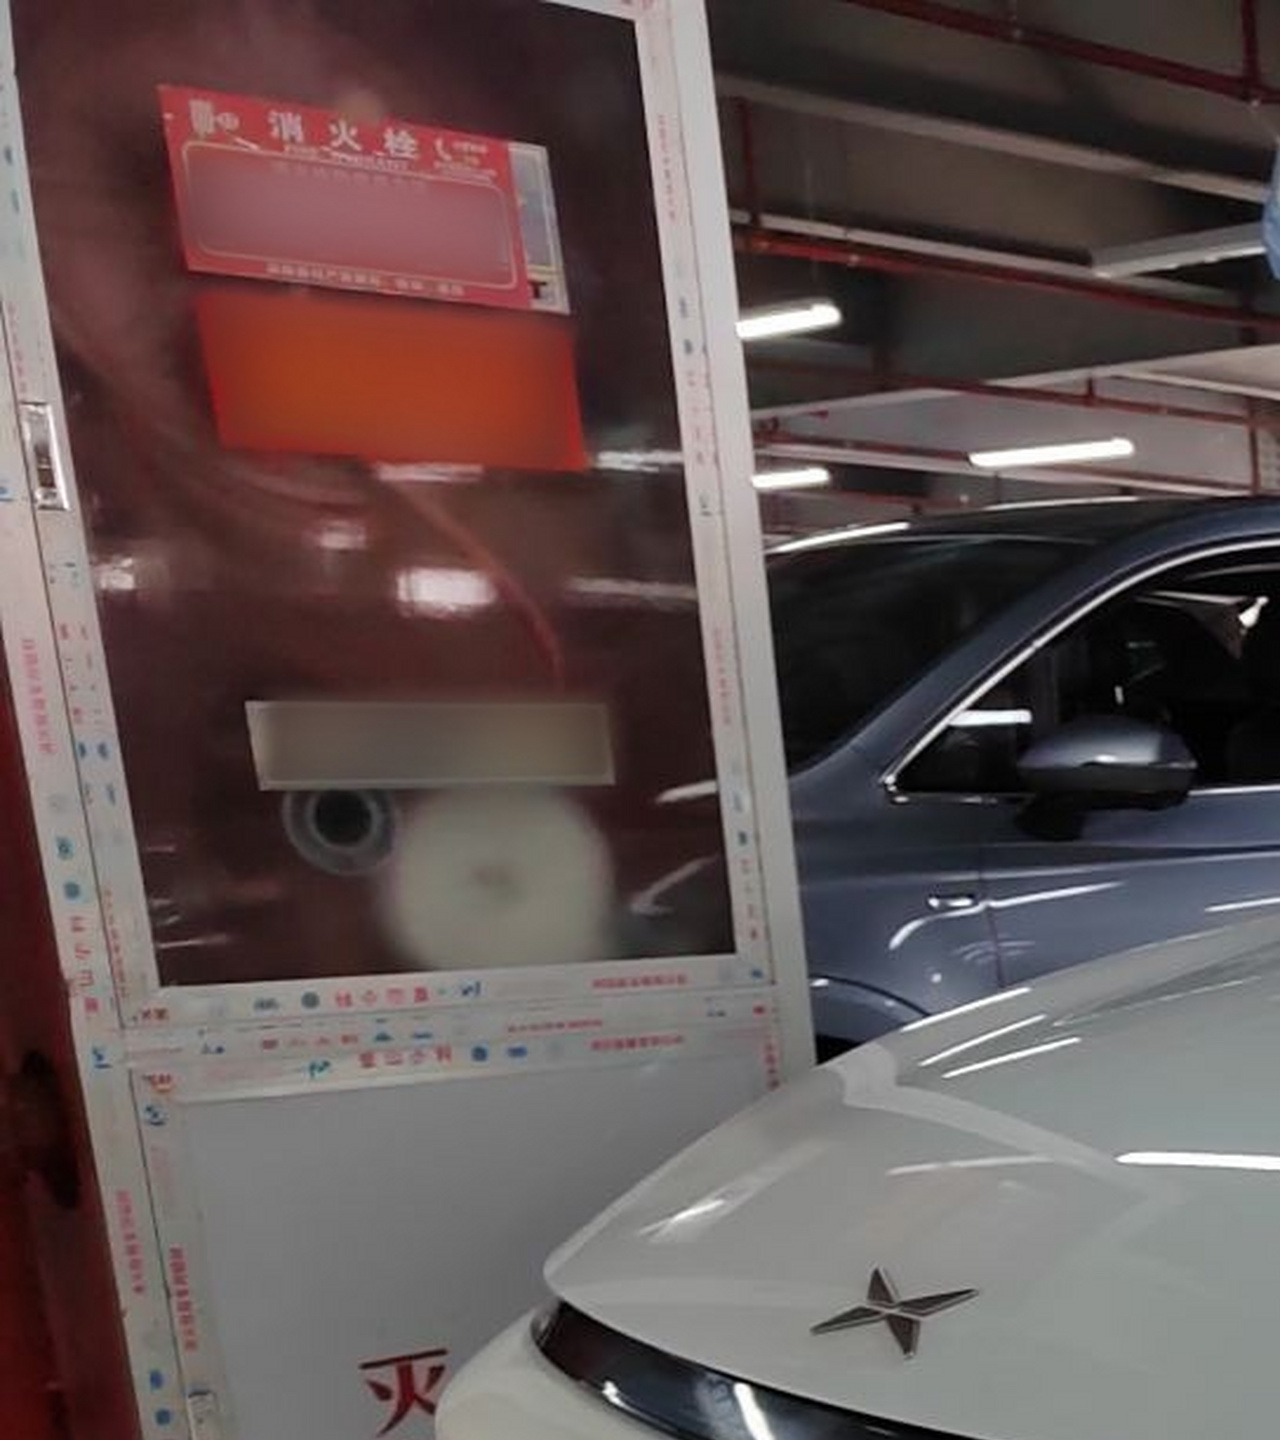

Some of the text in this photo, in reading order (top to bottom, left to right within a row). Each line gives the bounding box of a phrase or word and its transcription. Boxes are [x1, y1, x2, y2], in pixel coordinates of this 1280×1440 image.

[267, 109, 419, 160] 消火栓
[358, 1348, 447, 1438] 灭
